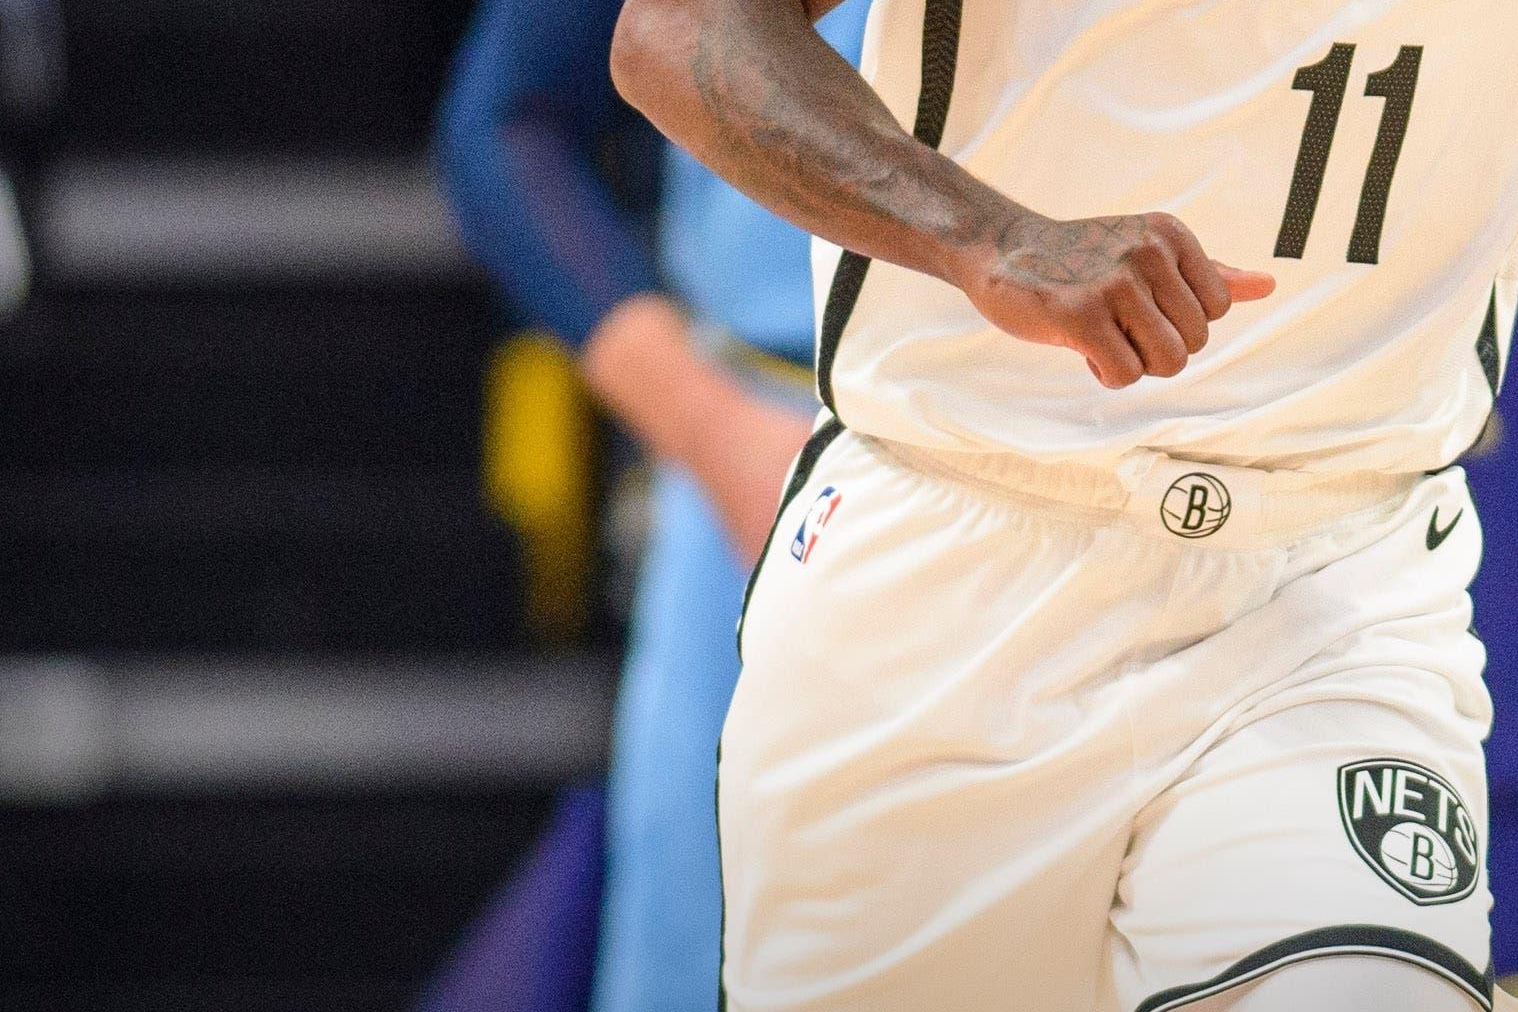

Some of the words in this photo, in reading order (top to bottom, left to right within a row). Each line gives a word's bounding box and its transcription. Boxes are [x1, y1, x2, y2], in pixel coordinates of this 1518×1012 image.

[1274, 42, 1424, 265] 11
[1182, 484, 1208, 530] B
[1352, 768, 1476, 865] NETS
[1410, 832, 1434, 880] B
